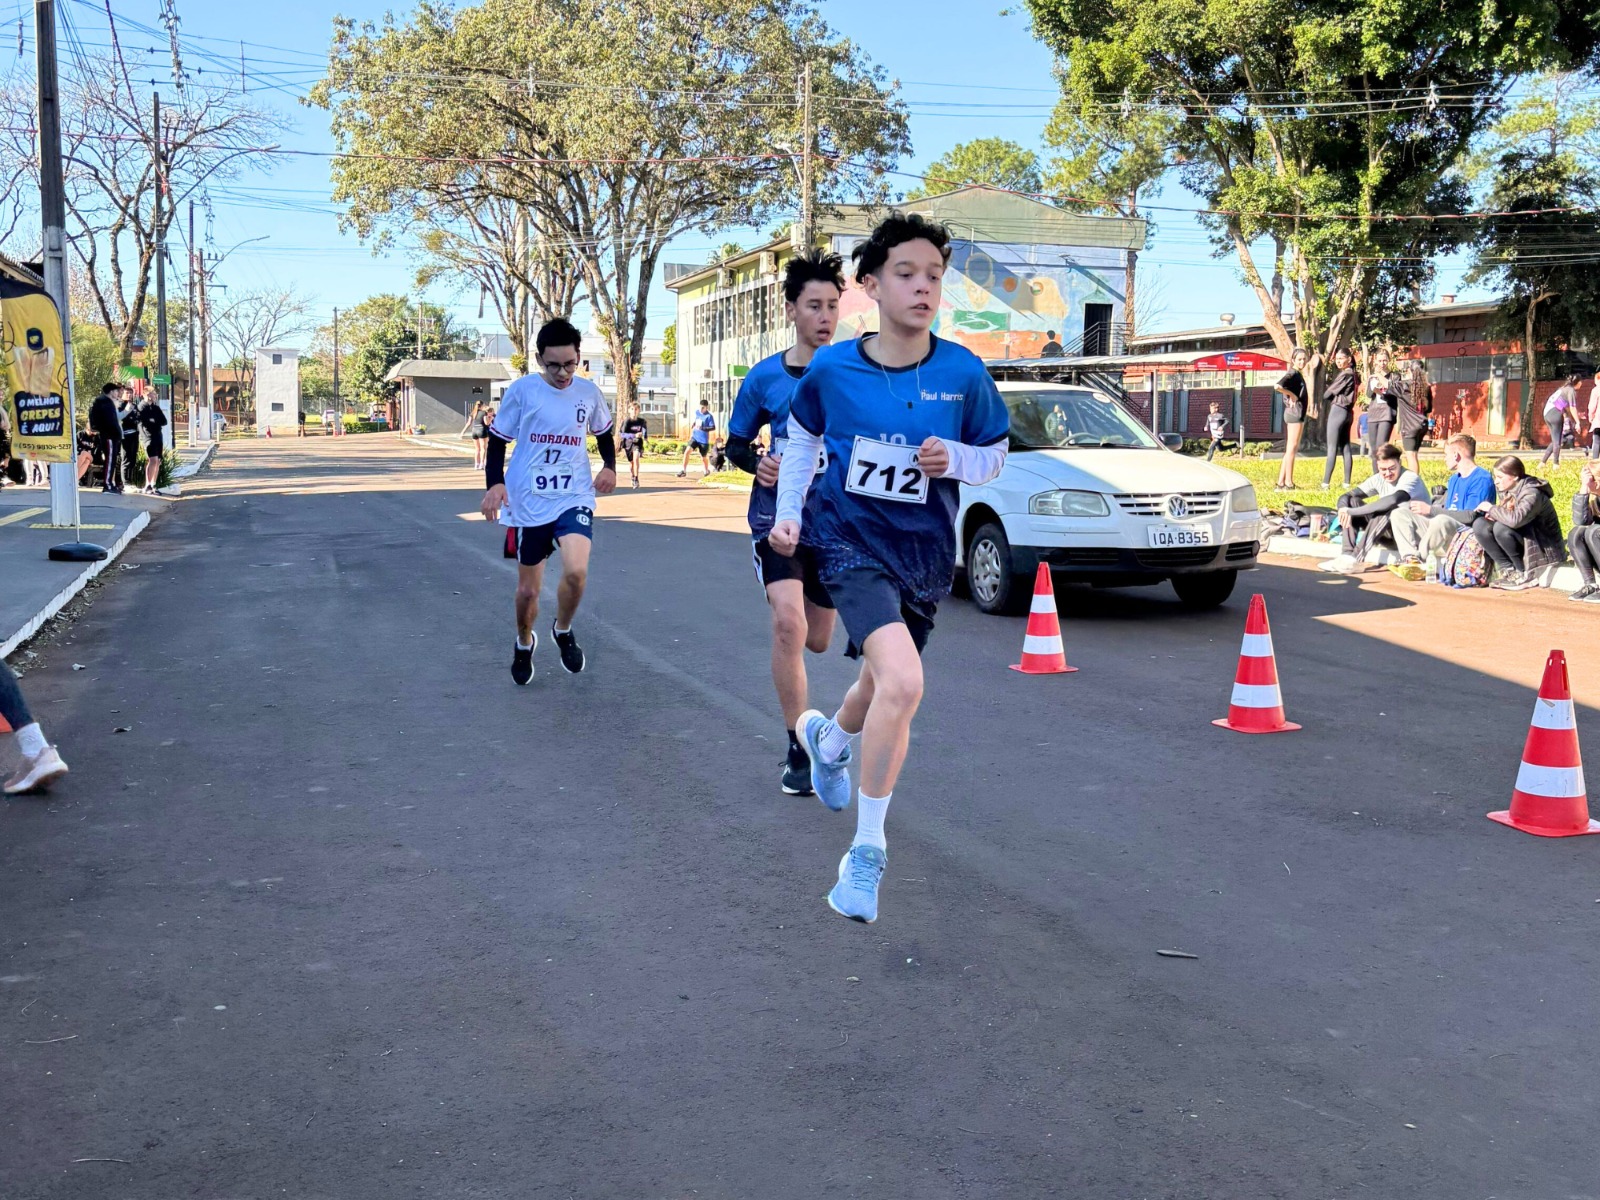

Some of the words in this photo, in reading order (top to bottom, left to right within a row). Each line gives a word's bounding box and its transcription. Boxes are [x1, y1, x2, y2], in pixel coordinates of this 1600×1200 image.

[19, 399, 26, 408] O
[27, 396, 60, 407] MELHOR
[921, 391, 938, 401] Paul
[940, 391, 964, 401] Harris
[20, 408, 61, 421] CREPES
[576, 408, 586, 423] G
[21, 422, 28, 434] É
[530, 433, 582, 446] GIORDANI
[543, 449, 561, 464] 17
[535, 474, 572, 490] 917
[857, 459, 922, 495] 712
